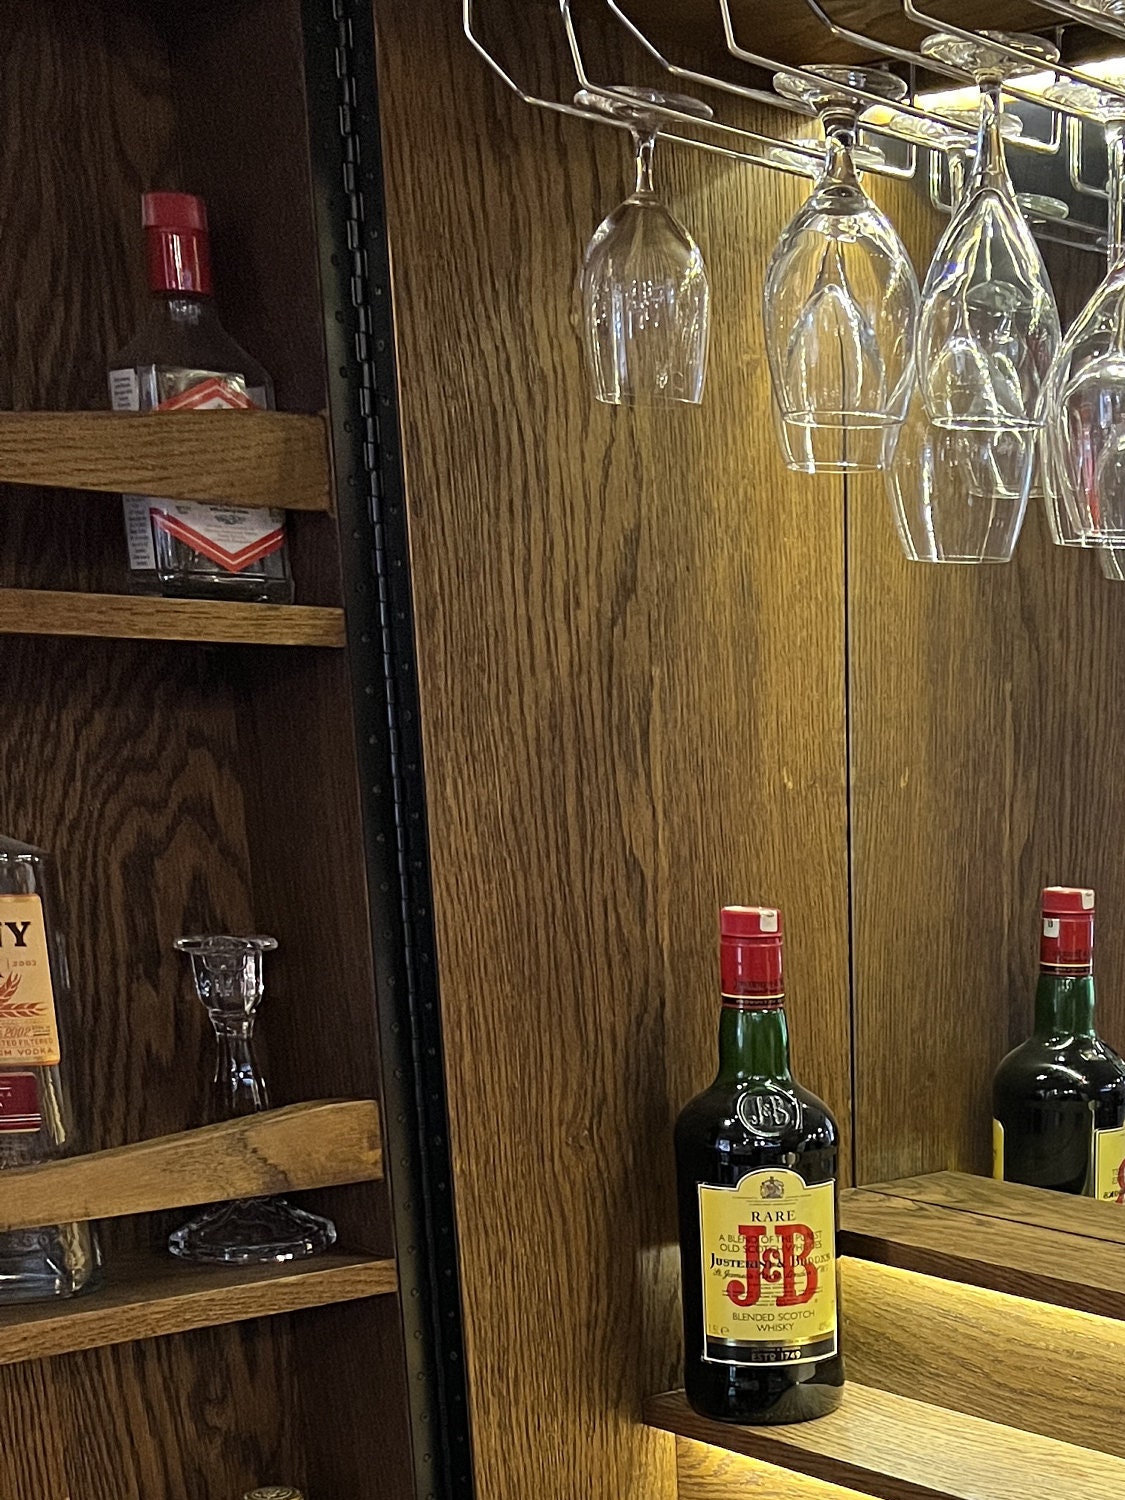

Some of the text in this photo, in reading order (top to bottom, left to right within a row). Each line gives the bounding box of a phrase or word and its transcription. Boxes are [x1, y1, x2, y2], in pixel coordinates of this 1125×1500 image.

[751, 1210, 797, 1223] RARE
[720, 1243, 740, 1252] OLD
[726, 1223, 819, 1308] J&B
[732, 1309, 815, 1322] BLENDED SCOTCH
[756, 1323, 794, 1332] WHISKY
[780, 1350, 801, 1361] 1749
